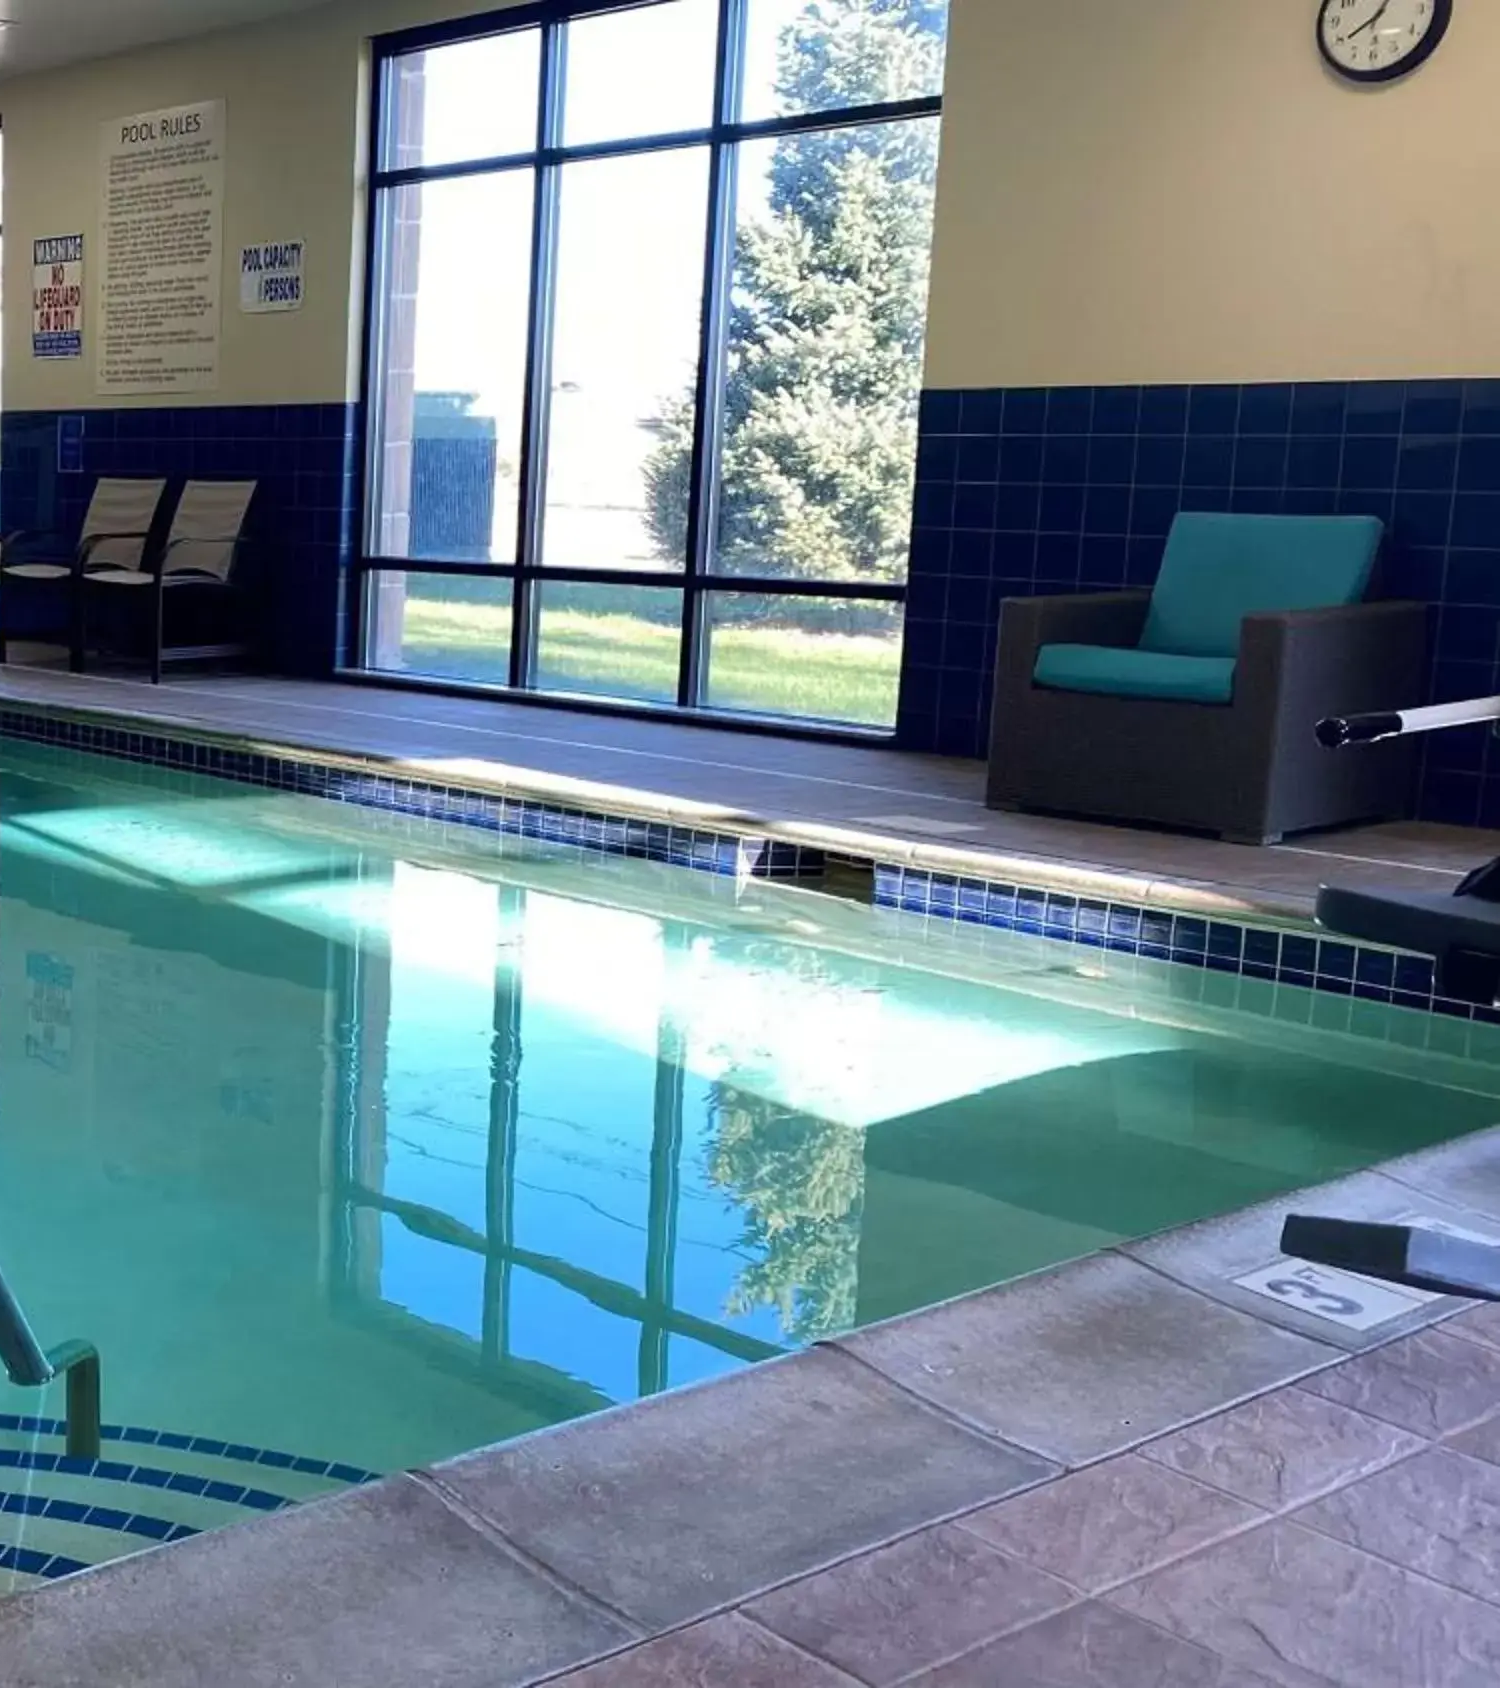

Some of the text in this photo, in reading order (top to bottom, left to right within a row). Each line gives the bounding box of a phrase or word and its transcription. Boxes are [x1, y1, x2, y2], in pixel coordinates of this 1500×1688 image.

[121, 113, 201, 143] POOL RULES
[34, 237, 82, 263] WARNING
[242, 243, 302, 272] POOL CAPACITY
[51, 264, 65, 286] NO
[34, 286, 81, 310] LIFEGUARD
[264, 276, 300, 302] PERSONS
[40, 309, 52, 330] ON
[53, 307, 75, 330] DUTY
[1267, 1279, 1364, 1316] 3
